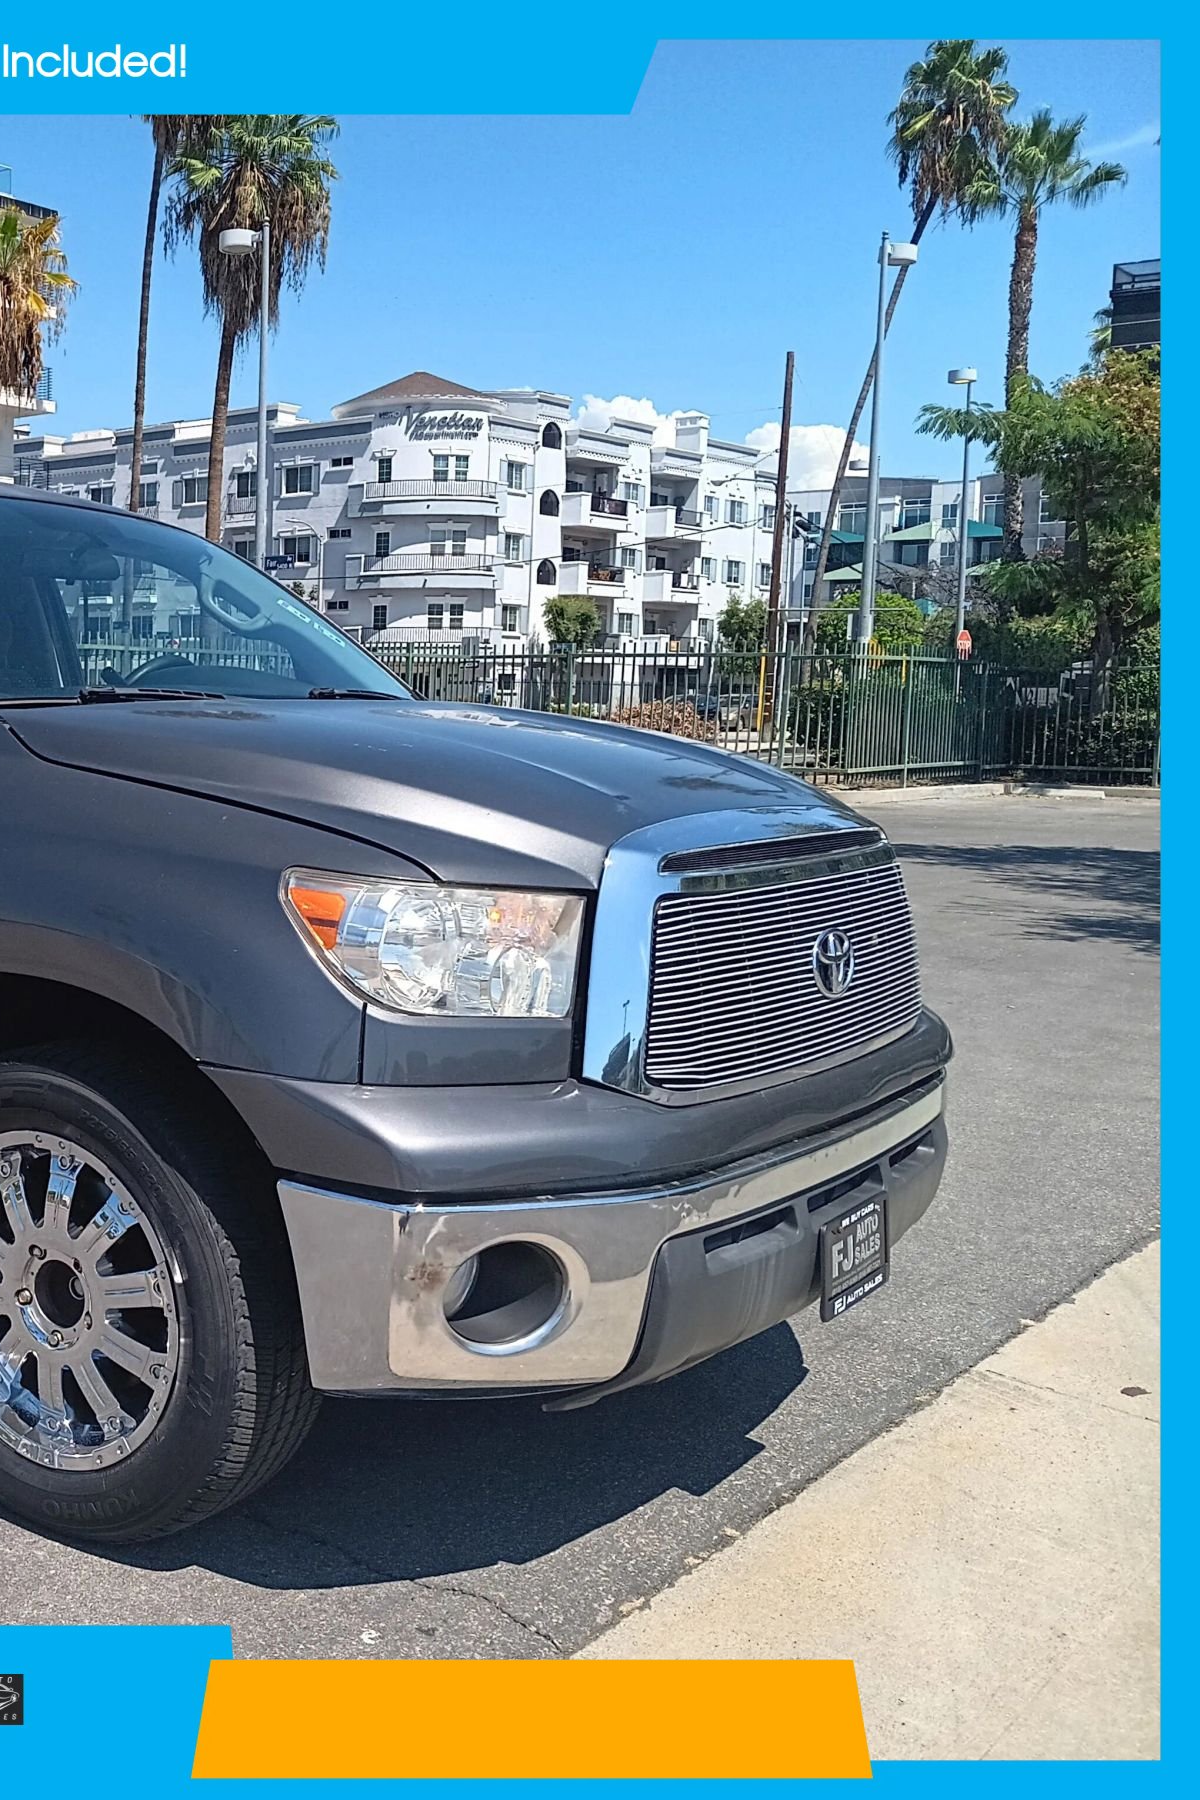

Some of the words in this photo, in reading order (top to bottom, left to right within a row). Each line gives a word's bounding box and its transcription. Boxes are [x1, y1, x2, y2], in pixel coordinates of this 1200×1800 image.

[400, 403, 484, 437] Venetian
[266, 559, 277, 567] Fair
[861, 1202, 875, 1217] CARS
[856, 1214, 879, 1243] AUTO
[832, 1234, 854, 1279] FJ
[855, 1232, 881, 1265] SALES
[834, 1295, 847, 1315] FJ
[847, 1289, 864, 1304] AUTO
[864, 1273, 883, 1292] SALES
